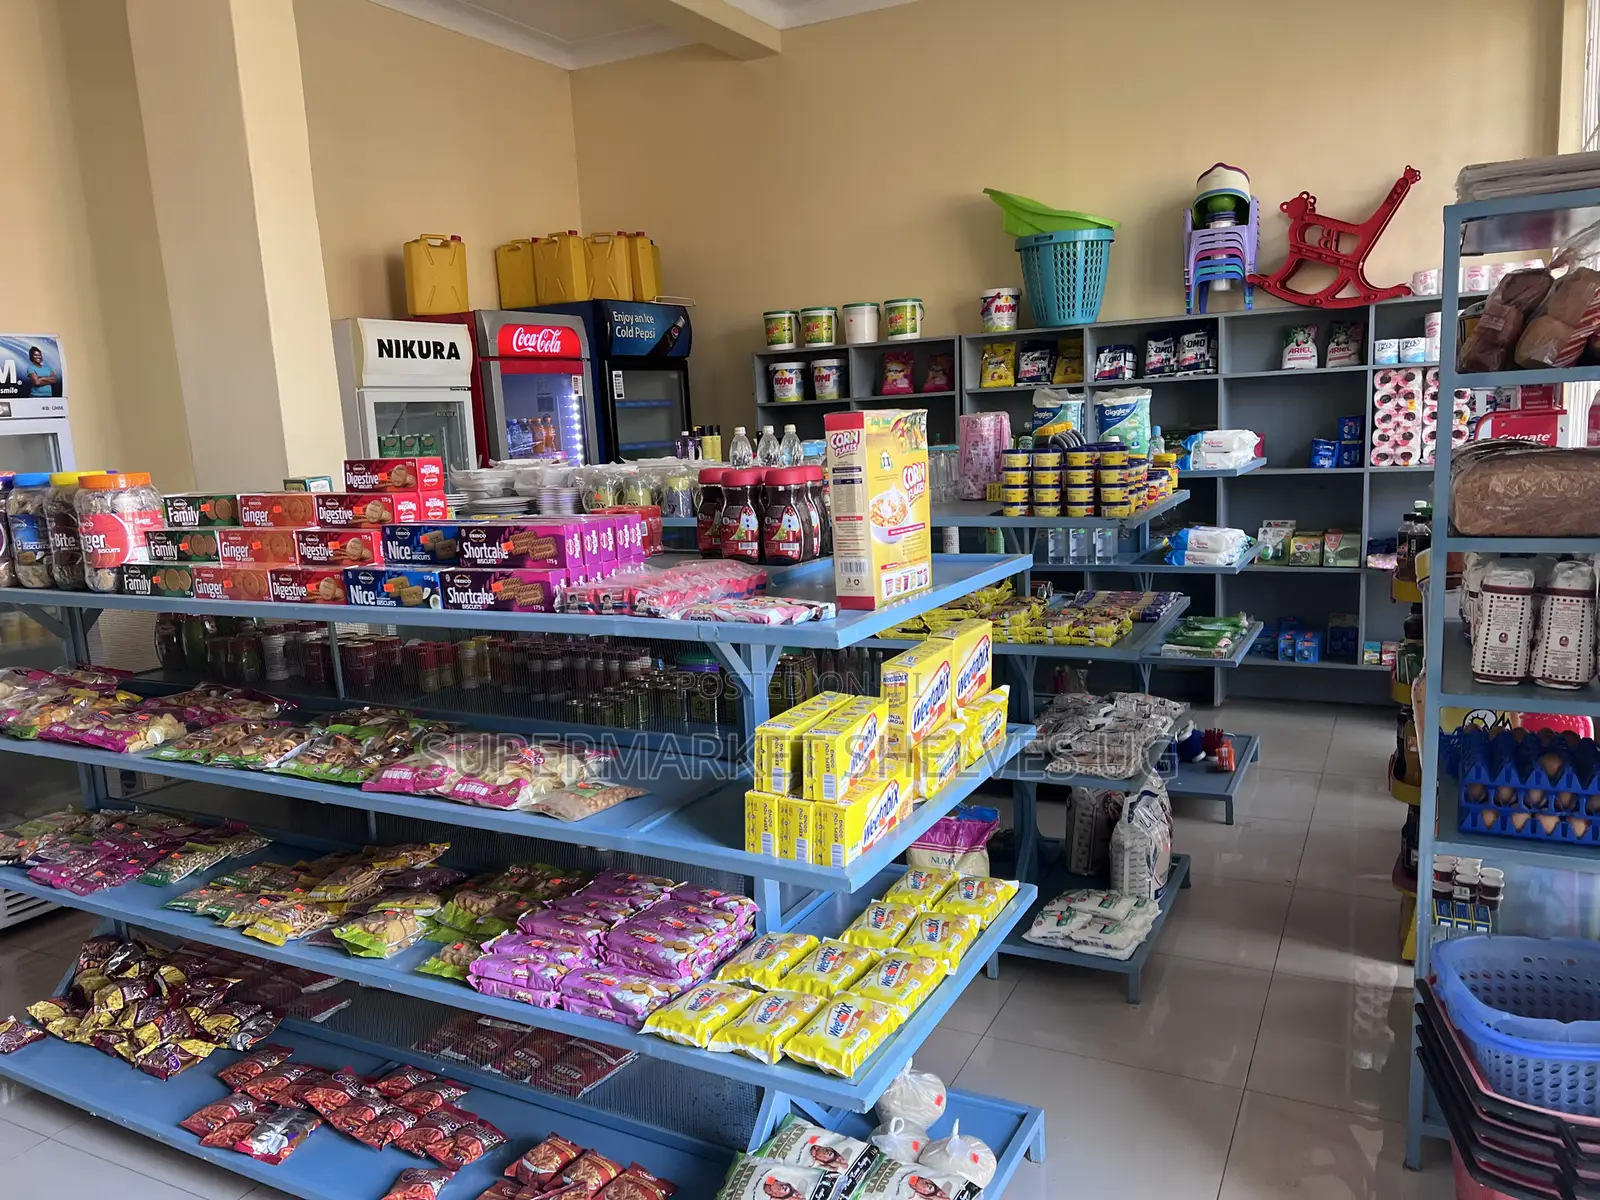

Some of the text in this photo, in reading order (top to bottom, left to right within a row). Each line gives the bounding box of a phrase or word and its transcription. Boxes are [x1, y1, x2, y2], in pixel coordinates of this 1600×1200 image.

[613, 311, 655, 325] Enjoy an Ice
[512, 327, 562, 354] Coca-Cola
[615, 326, 656, 341] Cold Pepsi
[377, 338, 461, 360] NIKURA
[1155, 345, 1173, 354] OMO
[1187, 339, 1206, 348] OMO
[830, 430, 860, 448] CORN
[835, 444, 859, 457] FLAKES
[346, 472, 379, 485] Digestive
[902, 462, 926, 489] CORN
[908, 483, 925, 502] FLAKES
[168, 507, 200, 526] Family
[242, 507, 268, 525] Ginger
[319, 507, 353, 521] Digestive
[54, 533, 75, 547] Bite
[150, 540, 178, 560] Family
[222, 542, 249, 561] Ginger
[299, 543, 334, 558] Digestive
[387, 541, 411, 560] Nice
[463, 541, 509, 560] Shortcake
[123, 574, 151, 595] Family
[195, 578, 222, 598] Ginger
[273, 582, 307, 597] Digestive
[350, 585, 376, 605] Nice
[448, 587, 495, 605] Shortcake
[957, 643, 990, 697] Weetabix
[913, 670, 951, 730] Weetabix
[863, 784, 900, 844] Weetabix
